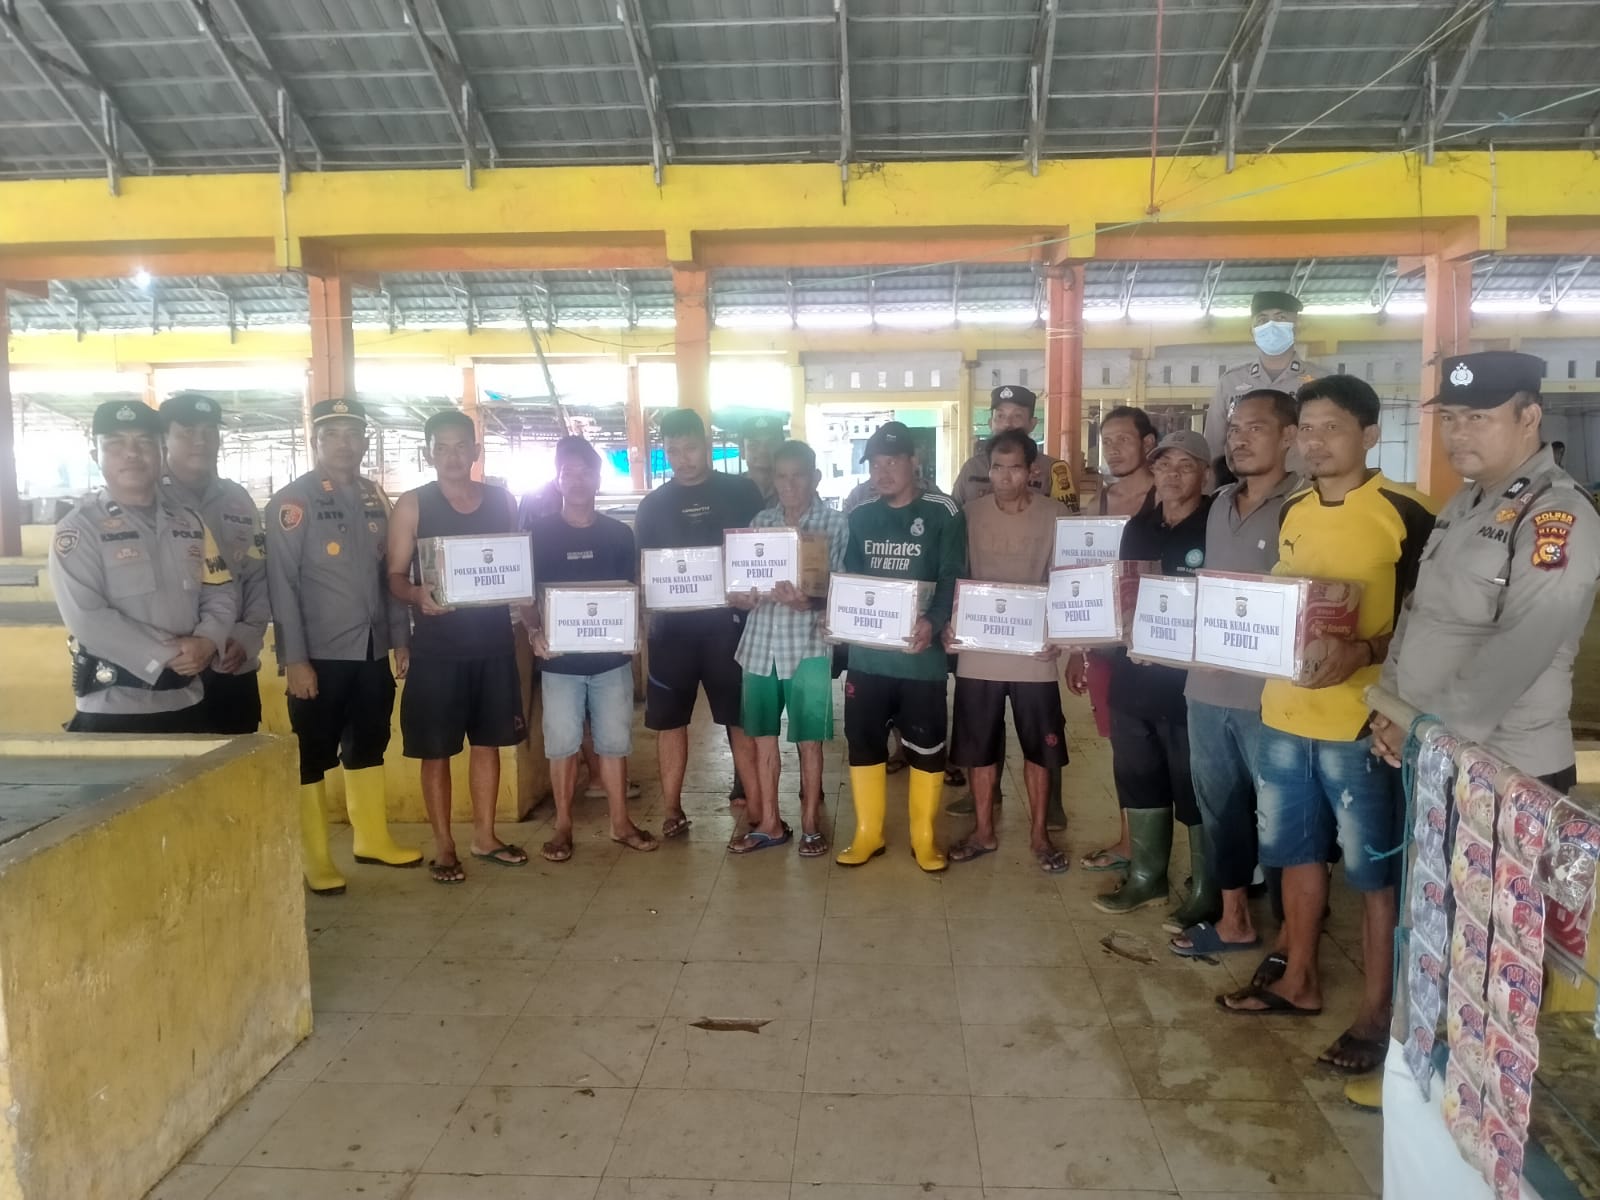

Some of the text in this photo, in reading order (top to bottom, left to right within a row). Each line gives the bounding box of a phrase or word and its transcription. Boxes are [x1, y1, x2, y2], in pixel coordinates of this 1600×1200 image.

[1478, 525, 1509, 544] POLRI
[864, 539, 922, 557] Emirates
[870, 556, 910, 571] FLY BETTER
[454, 568, 478, 576] POLSEK
[478, 566, 498, 575] KUALA
[746, 568, 774, 578] PEDULI
[474, 574, 506, 587] PEDULI
[669, 583, 698, 594] PEDULI
[965, 613, 987, 622] POLSEK
[989, 615, 1009, 624] KUALA
[1064, 610, 1090, 622] PEDULI
[558, 619, 581, 627] POLSEK
[582, 618, 601, 626] KUALA
[854, 616, 883, 629] PEDULI
[1203, 616, 1280, 636] POLSEK KUALA CENAKU
[577, 627, 607, 638] PEDULI
[983, 624, 1016, 636] PEDULI
[1150, 626, 1176, 641] PEDULI
[1223, 632, 1259, 651] PEDULI
